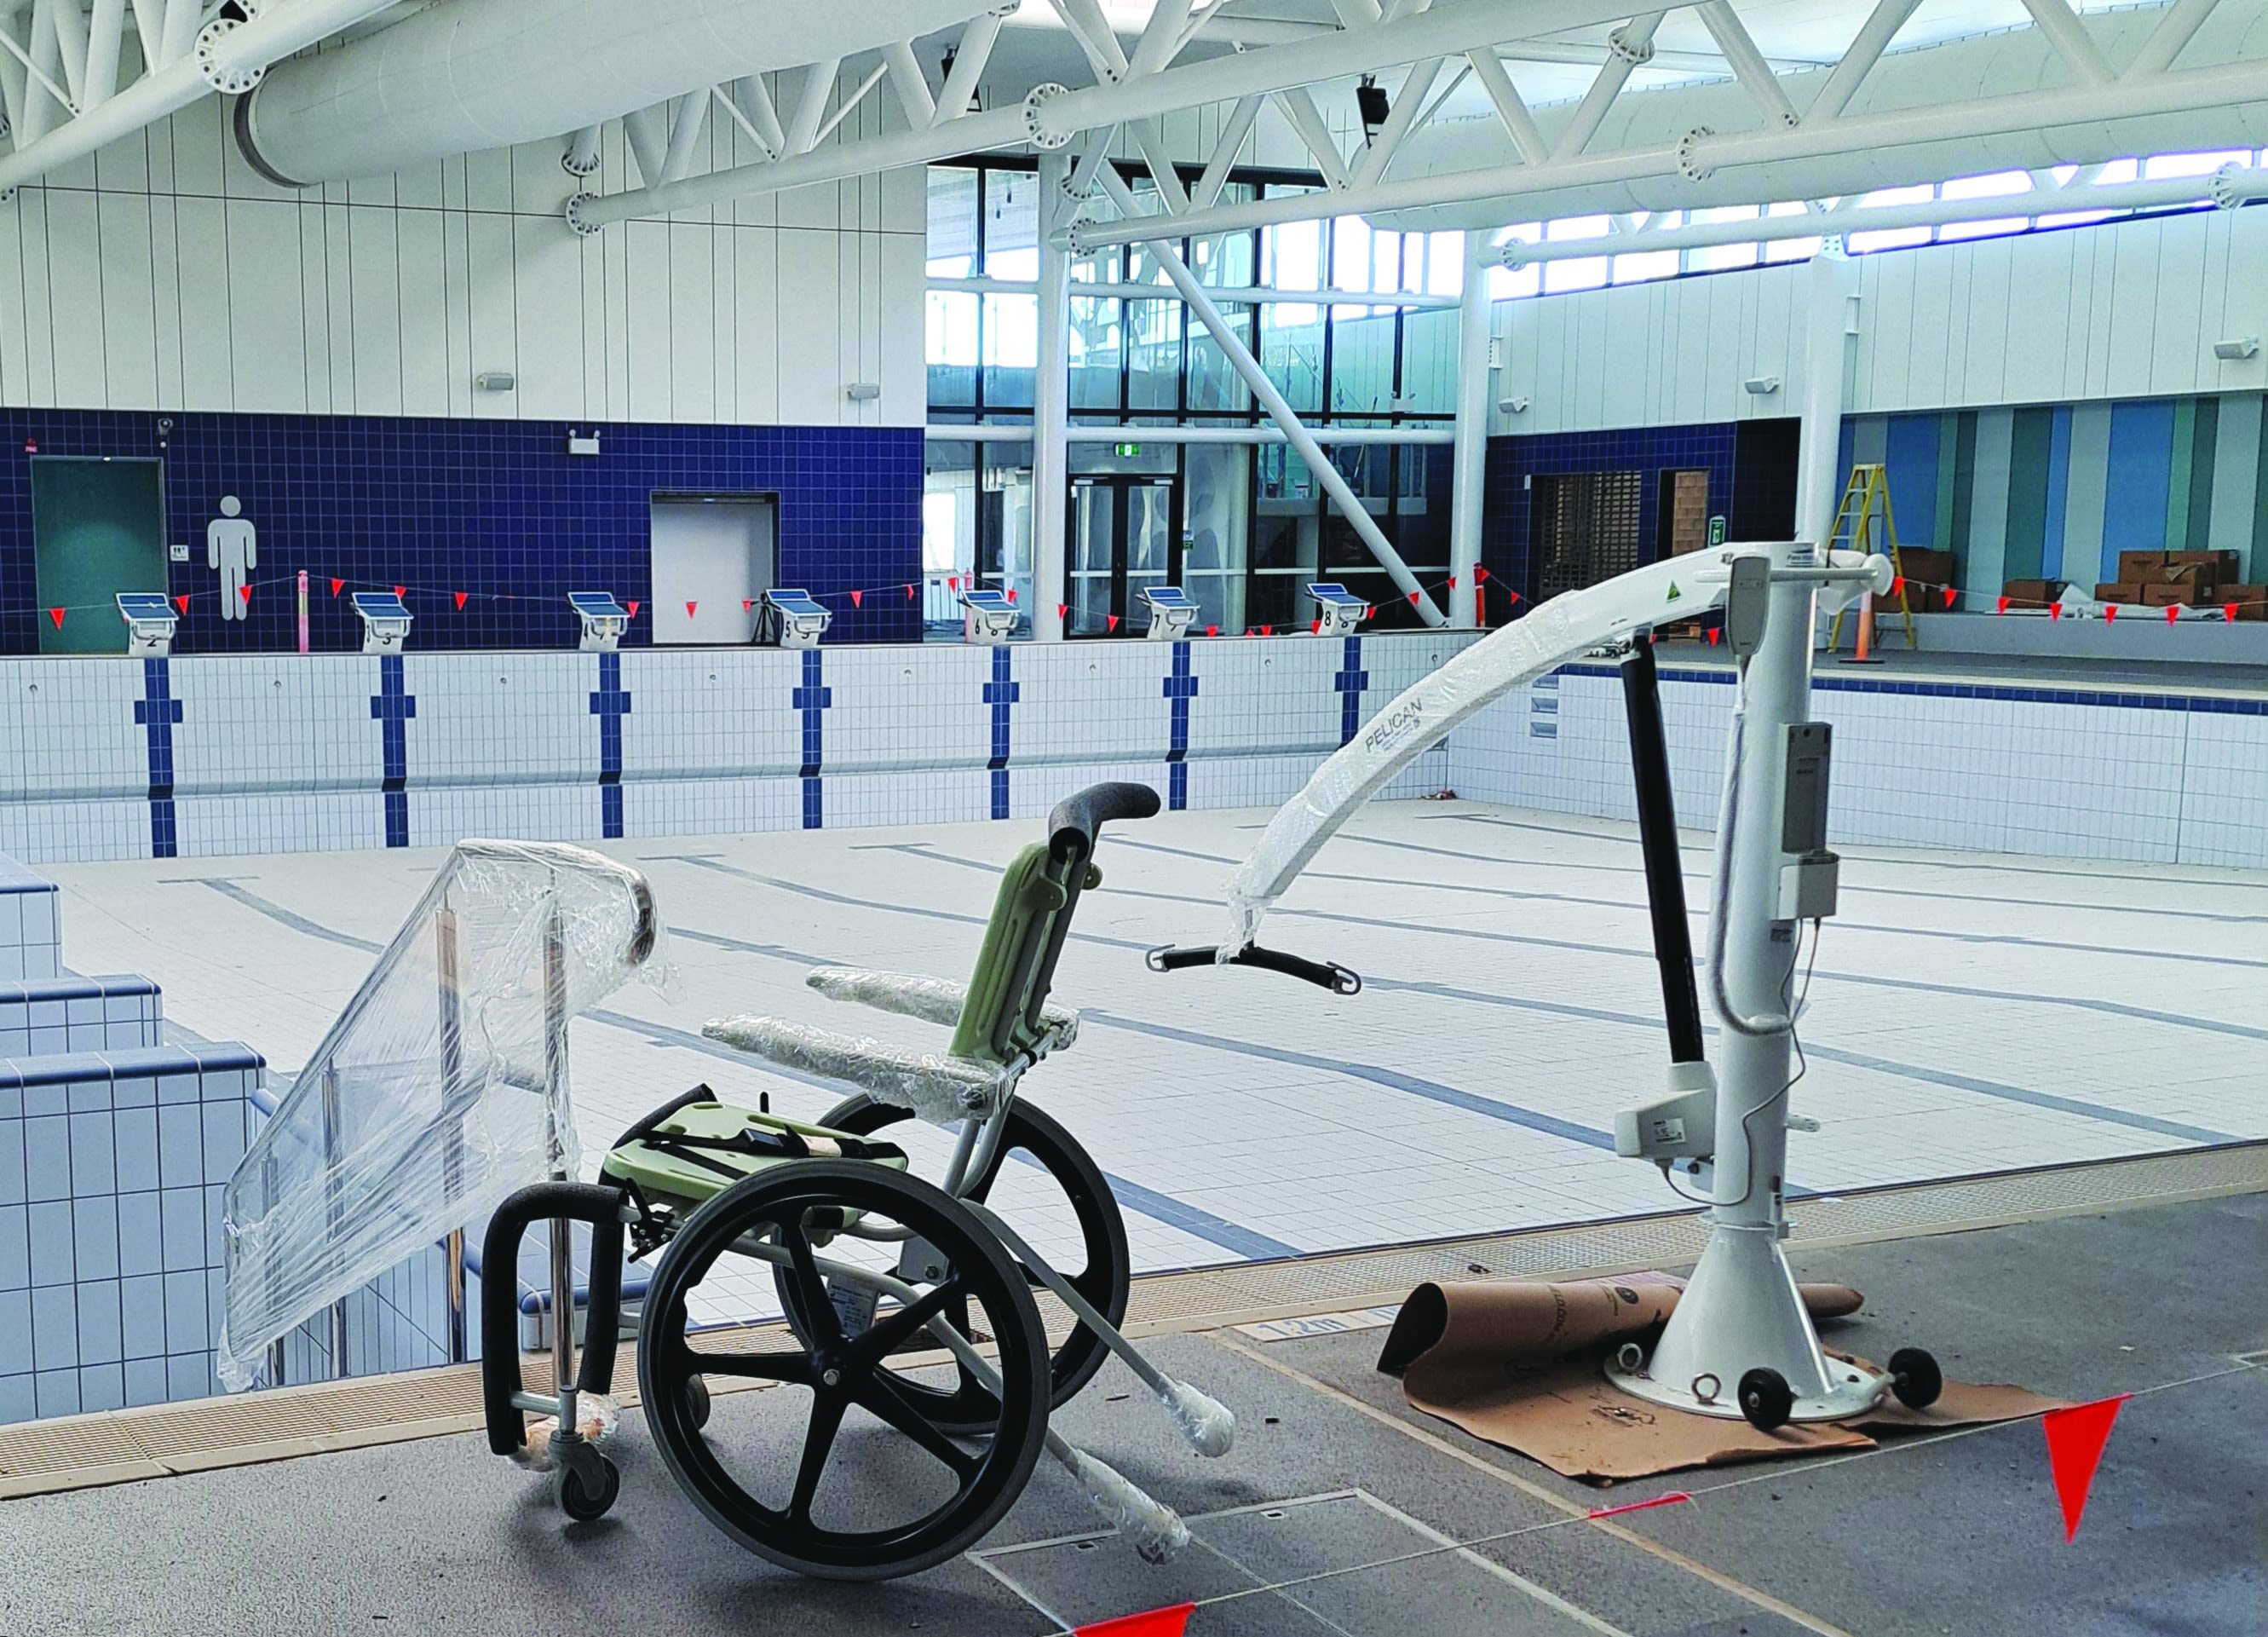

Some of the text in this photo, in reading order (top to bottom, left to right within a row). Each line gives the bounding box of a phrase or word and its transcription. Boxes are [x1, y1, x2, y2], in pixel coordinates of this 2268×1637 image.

[975, 618, 981, 635] 6
[1154, 614, 1160, 631] 7
[1324, 610, 1332, 627] 8
[786, 620, 791, 638] 5
[1365, 697, 1423, 753] PELICAN
